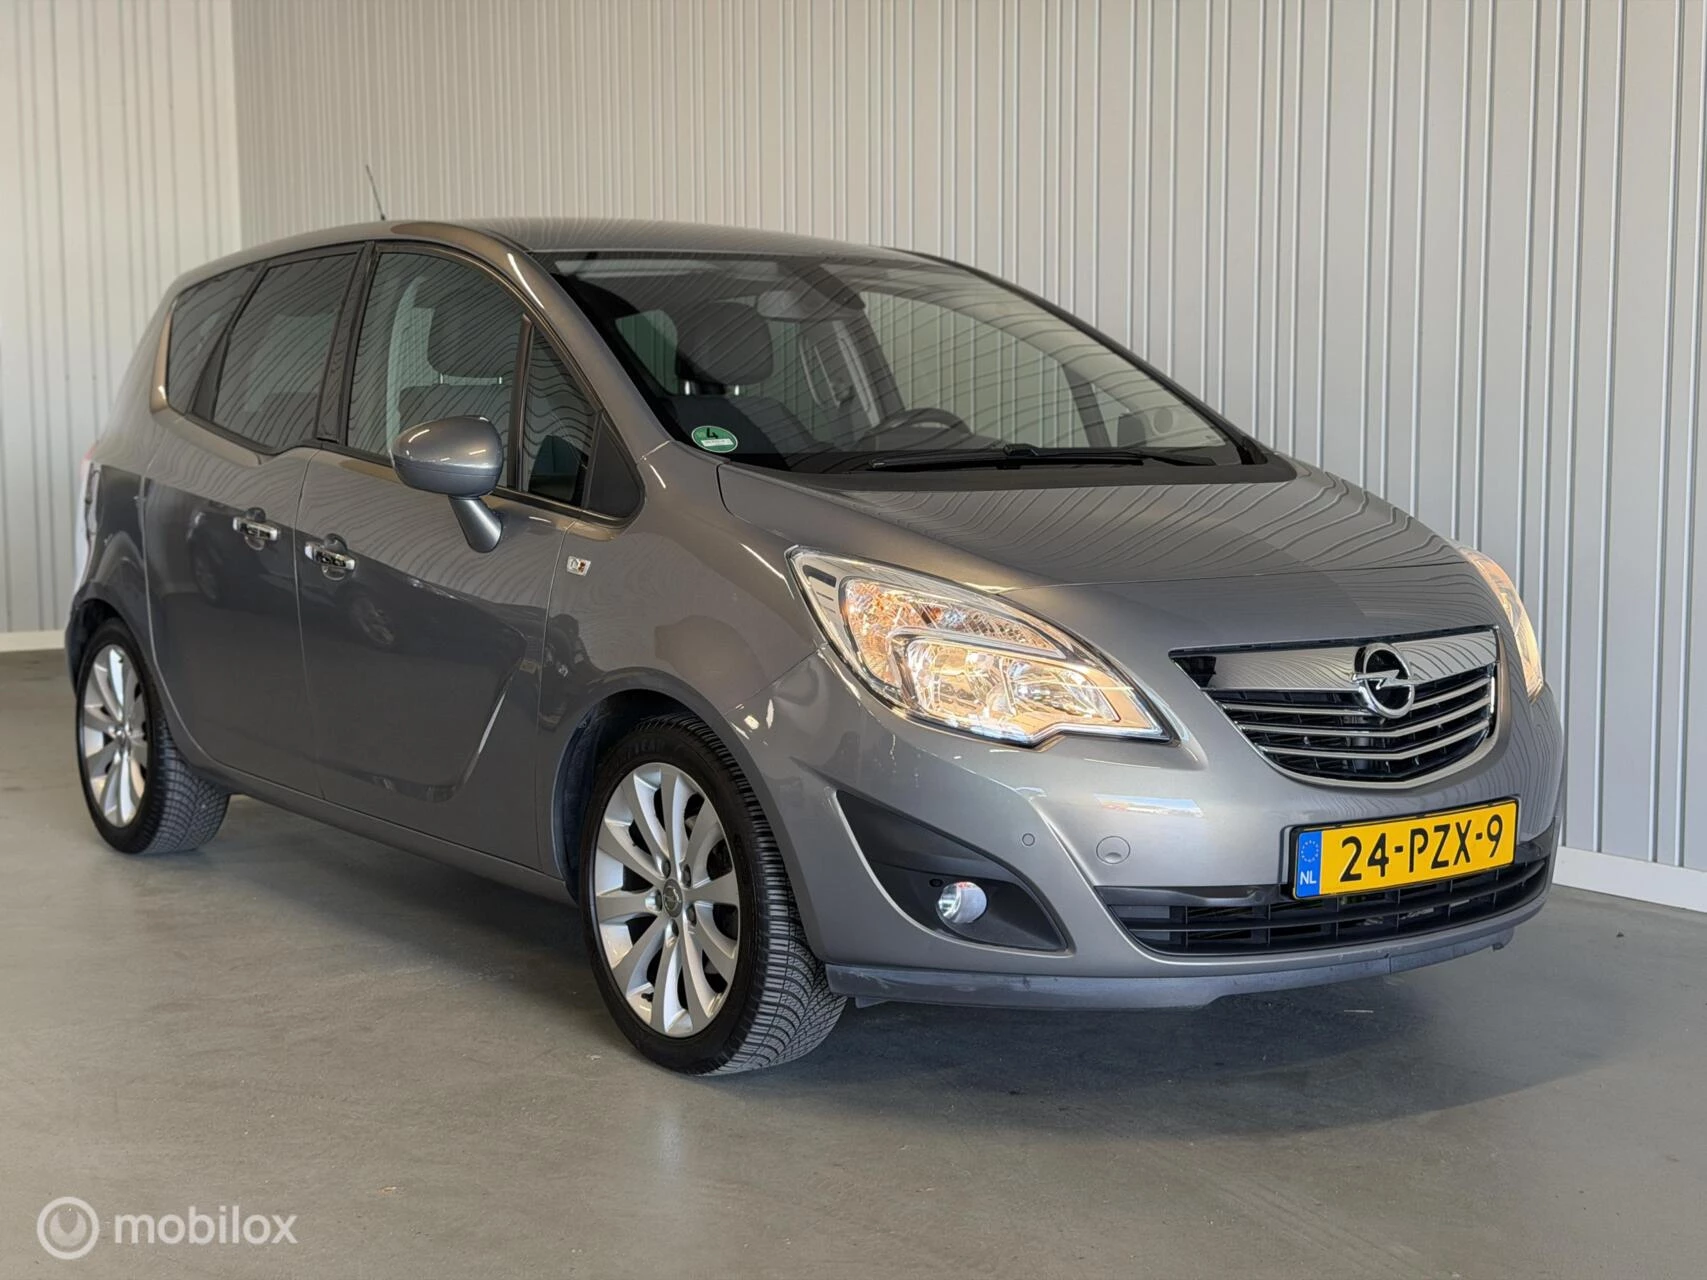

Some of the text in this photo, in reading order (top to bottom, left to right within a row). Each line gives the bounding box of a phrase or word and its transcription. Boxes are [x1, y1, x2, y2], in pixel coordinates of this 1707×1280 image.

[706, 427, 719, 439] 4
[1339, 814, 1503, 883] 24-PZX-9
[1299, 869, 1317, 885] NL
